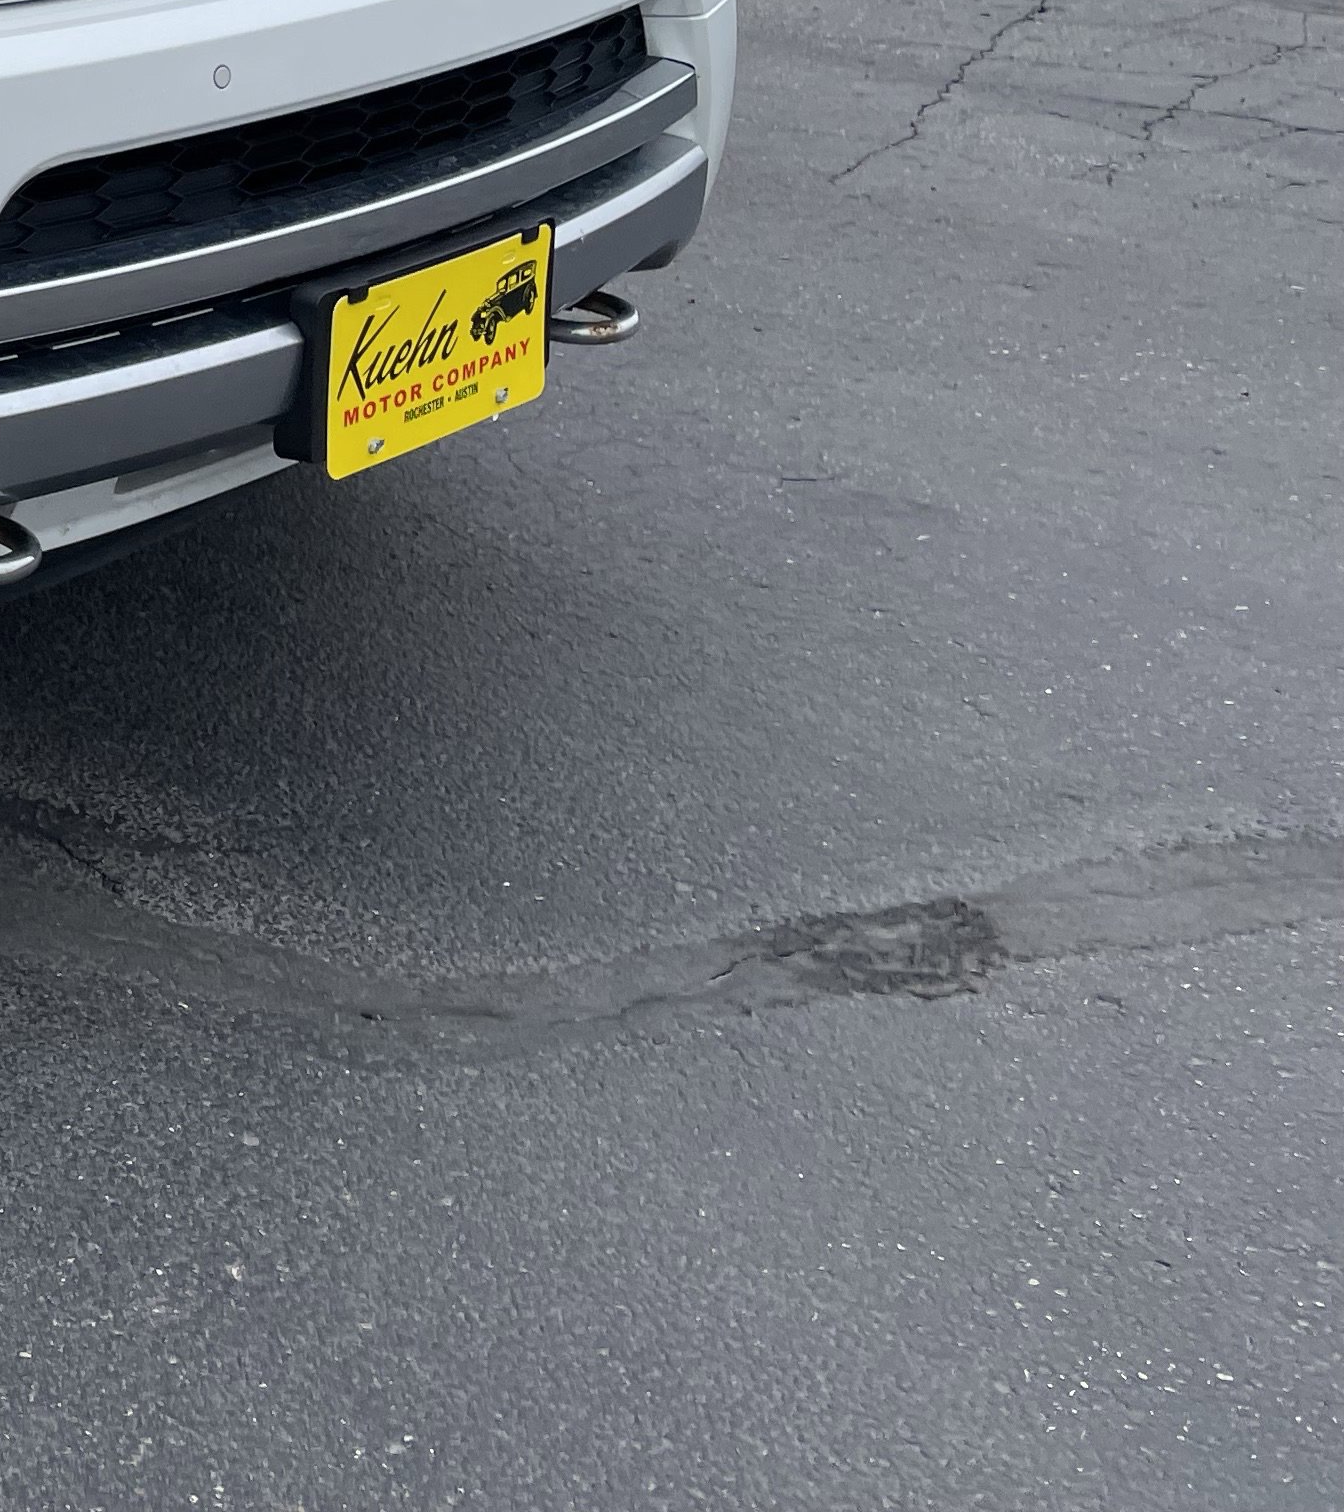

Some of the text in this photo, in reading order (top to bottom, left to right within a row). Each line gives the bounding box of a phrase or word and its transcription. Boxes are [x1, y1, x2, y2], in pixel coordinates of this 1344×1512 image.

[337, 289, 460, 402] Kuehn
[343, 337, 531, 428] MOTOR COMPANY
[404, 381, 479, 423] ROCHESTER AUSTIN
